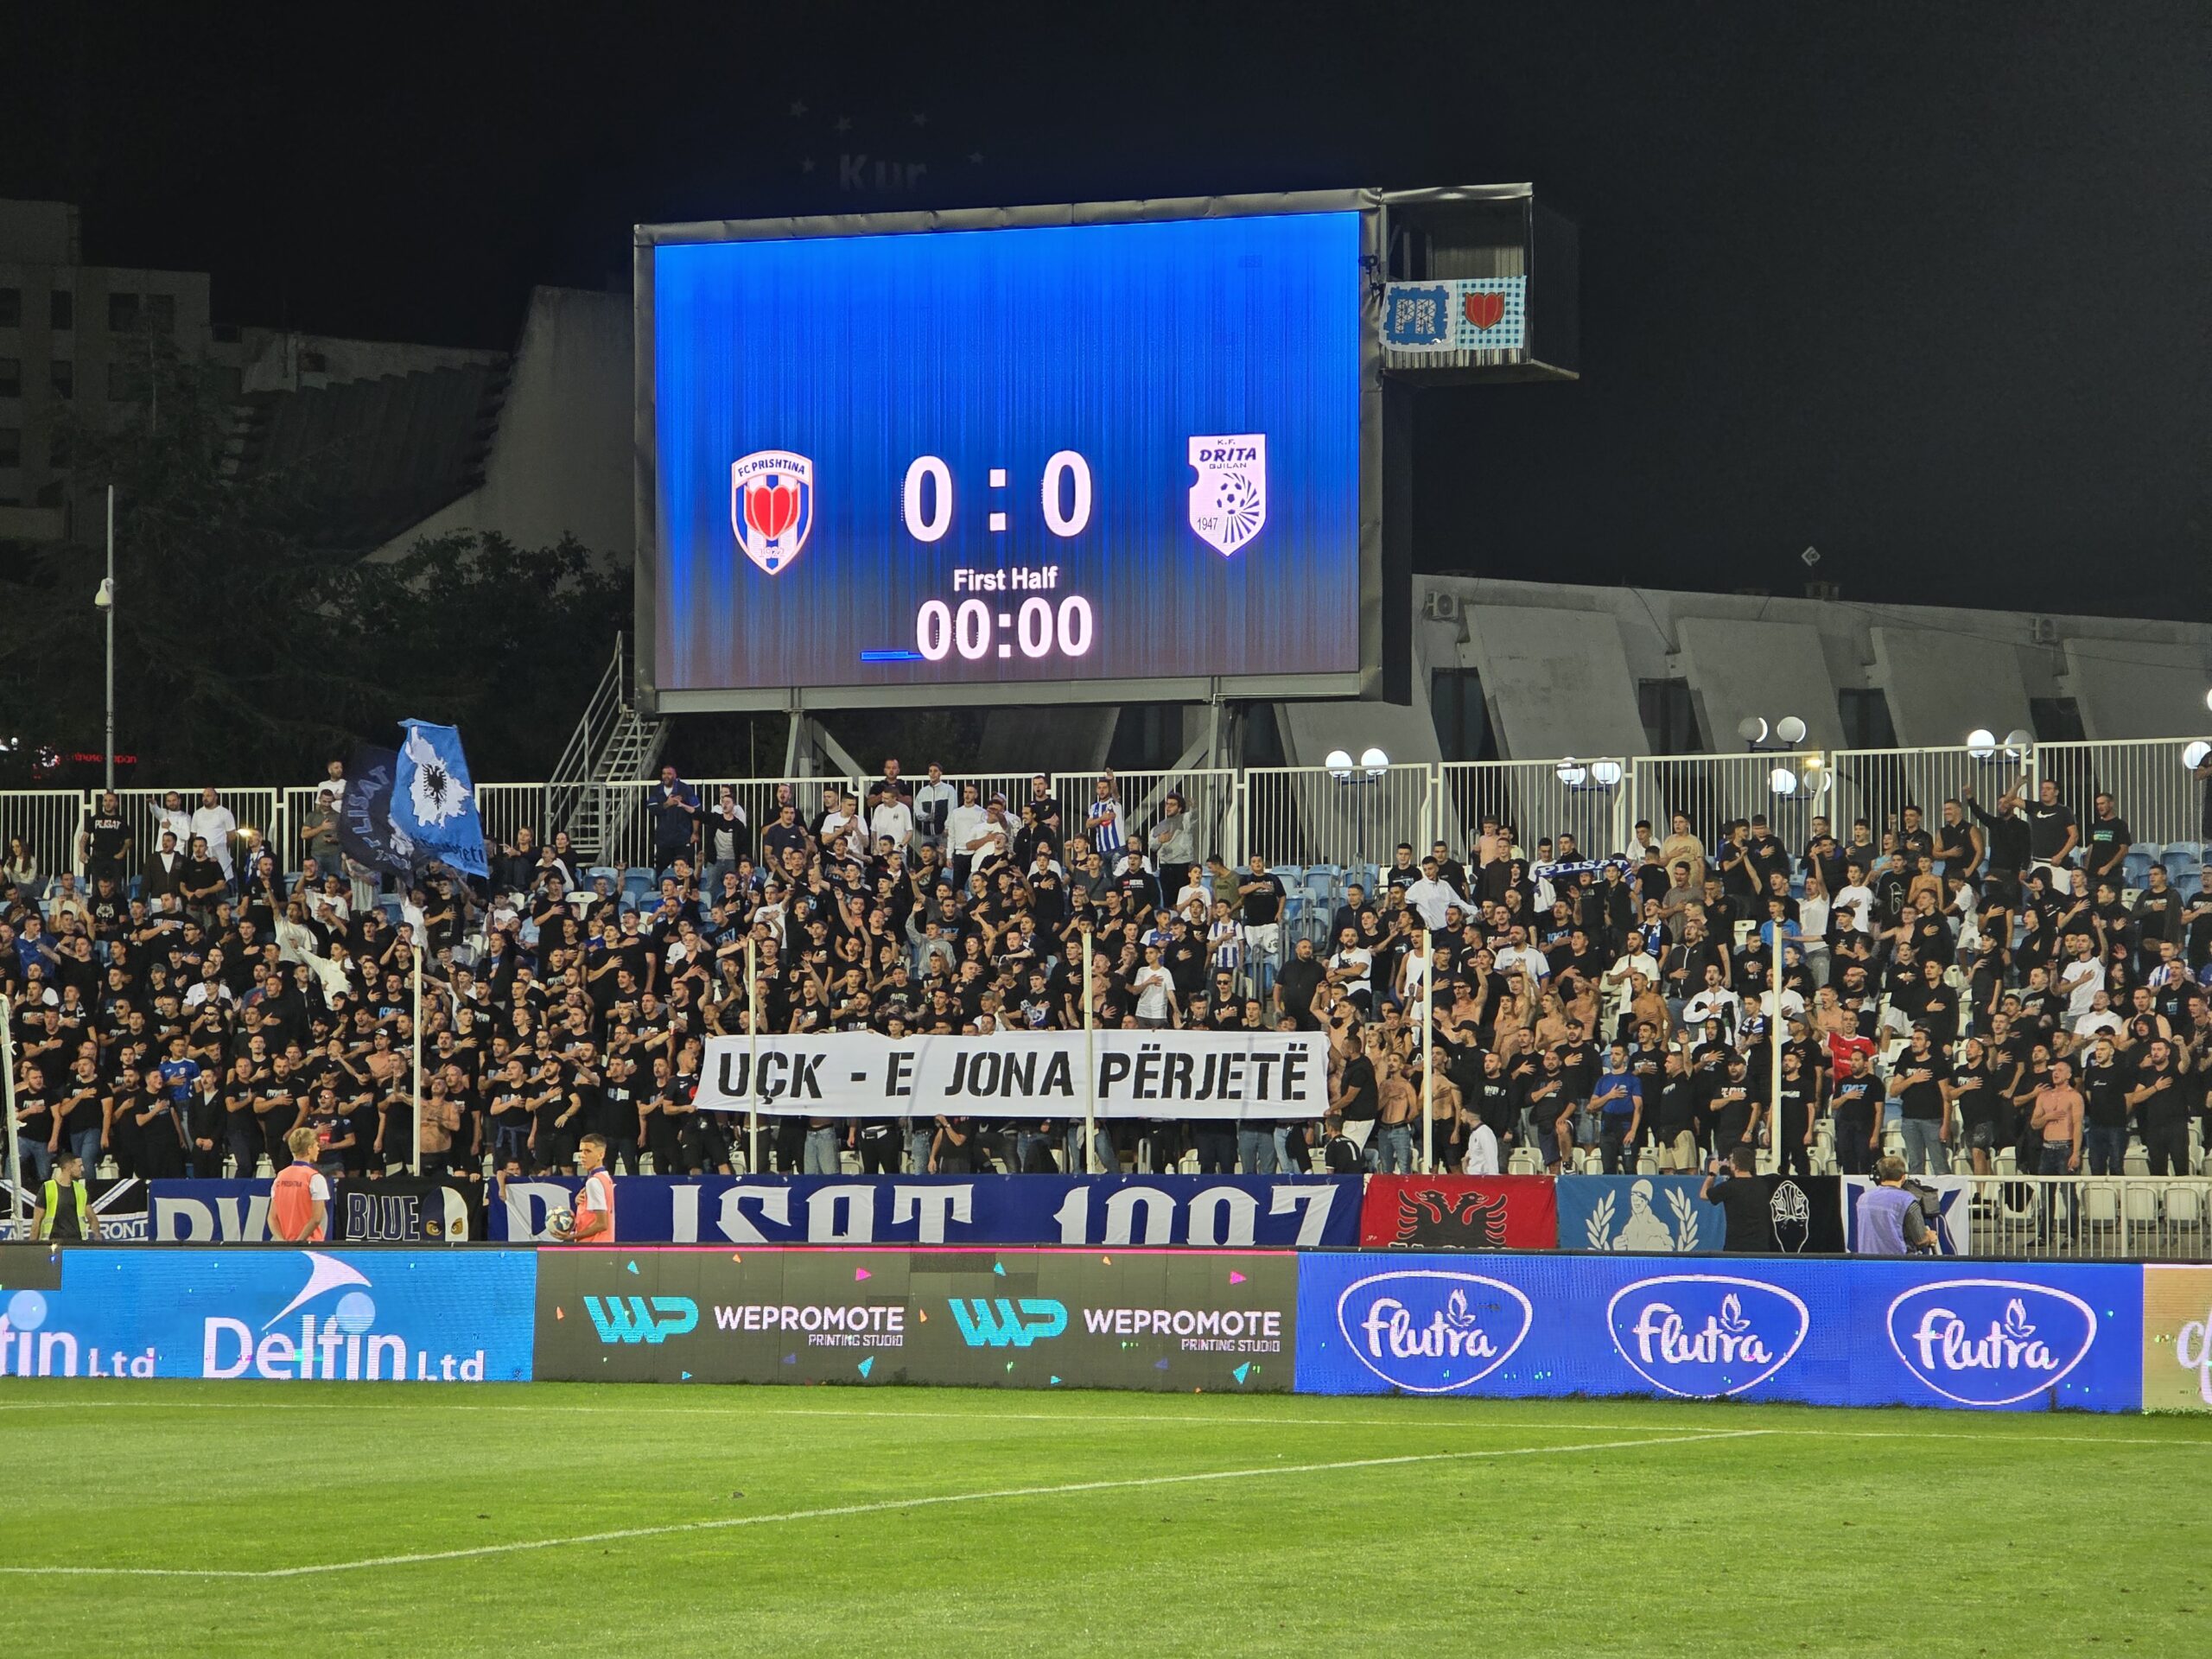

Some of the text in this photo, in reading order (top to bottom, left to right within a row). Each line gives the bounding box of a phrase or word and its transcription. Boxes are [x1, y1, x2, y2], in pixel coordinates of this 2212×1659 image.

[1395, 298, 1436, 334] PR
[737, 458, 806, 477] FC PRISHTINA
[1198, 448, 1257, 462] DRITA
[904, 455, 952, 542] 0
[1042, 450, 1091, 537] 0
[1197, 518, 1218, 531] 1947
[954, 566, 1058, 592] First Half
[917, 595, 1093, 661] 00:00
[1536, 859, 1629, 876] PLISAT
[718, 1052, 827, 1105] UÇK
[885, 1052, 915, 1097] E
[944, 1052, 1075, 1097] JONA
[1097, 1043, 1309, 1101] PËRJETË
[346, 1192, 421, 1241] BLUE
[713, 1305, 906, 1332] WEPROMOTE
[1084, 1308, 1281, 1337] WEPROMOTE
[0, 1291, 156, 1378] fin Ltd
[203, 1293, 485, 1382] Delfin Ltd
[808, 1333, 904, 1347] PRINTING STUDIO
[1180, 1338, 1281, 1353] PRINTING STUDIO
